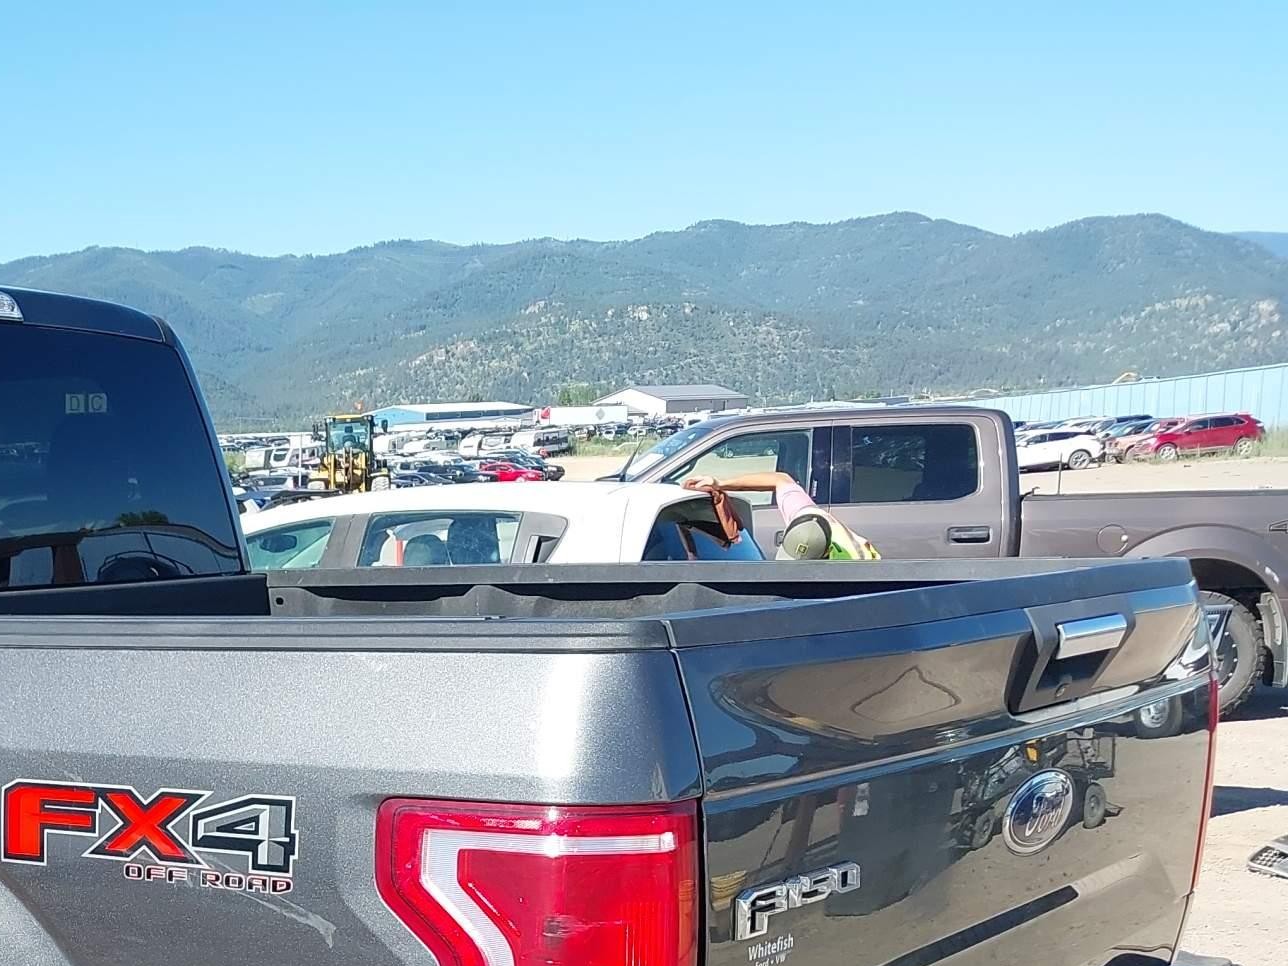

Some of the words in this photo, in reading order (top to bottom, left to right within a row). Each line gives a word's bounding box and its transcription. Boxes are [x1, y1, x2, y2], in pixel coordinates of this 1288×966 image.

[1, 778, 300, 877] FX4
[123, 863, 188, 884] OFF
[200, 870, 294, 895] ROAD
[748, 933, 795, 962] Whitefish
[775, 953, 787, 966] VW
